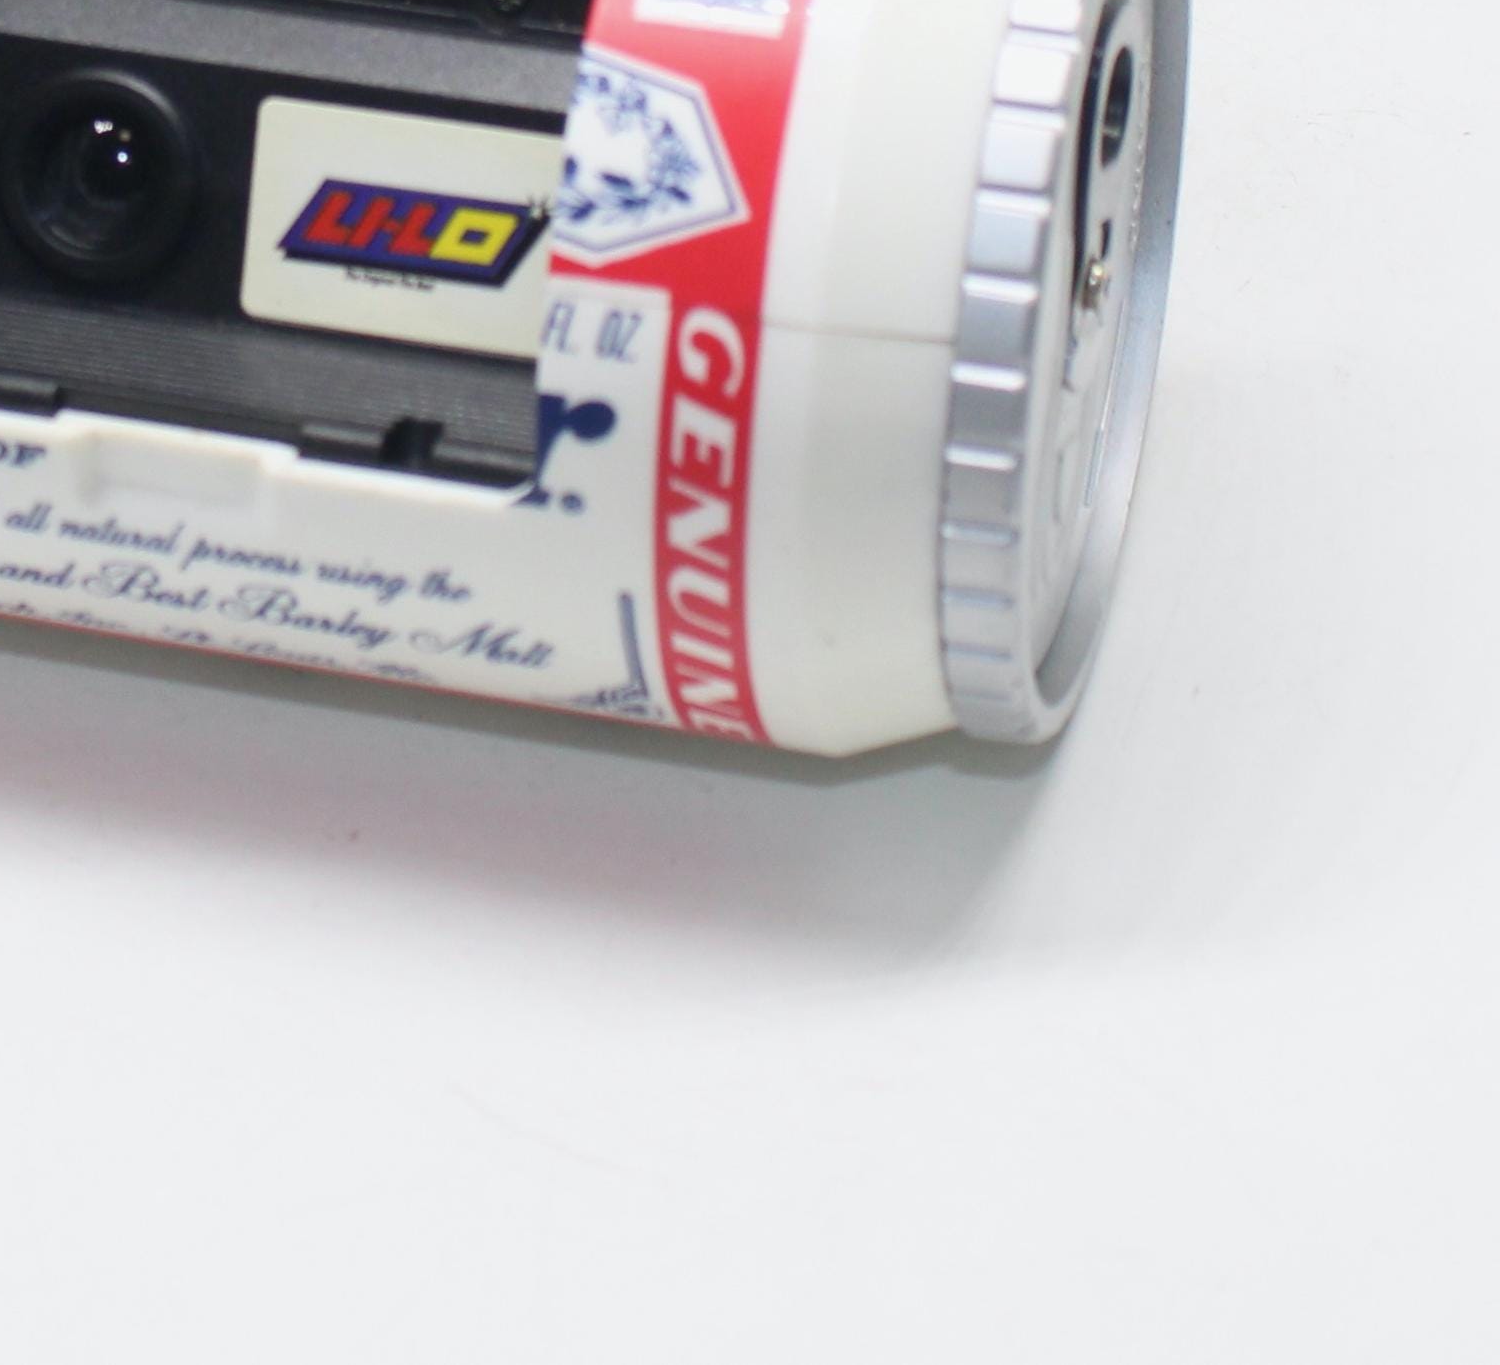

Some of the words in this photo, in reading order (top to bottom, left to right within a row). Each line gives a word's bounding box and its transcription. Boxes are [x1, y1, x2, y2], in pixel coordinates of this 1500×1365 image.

[4, 503, 49, 534] all
[59, 516, 181, 557] natural
[182, 536, 303, 574] process
[316, 557, 409, 602] using
[419, 567, 472, 604] the
[81, 559, 211, 612] Best
[217, 584, 394, 648] Barley
[409, 622, 555, 669] Malt
